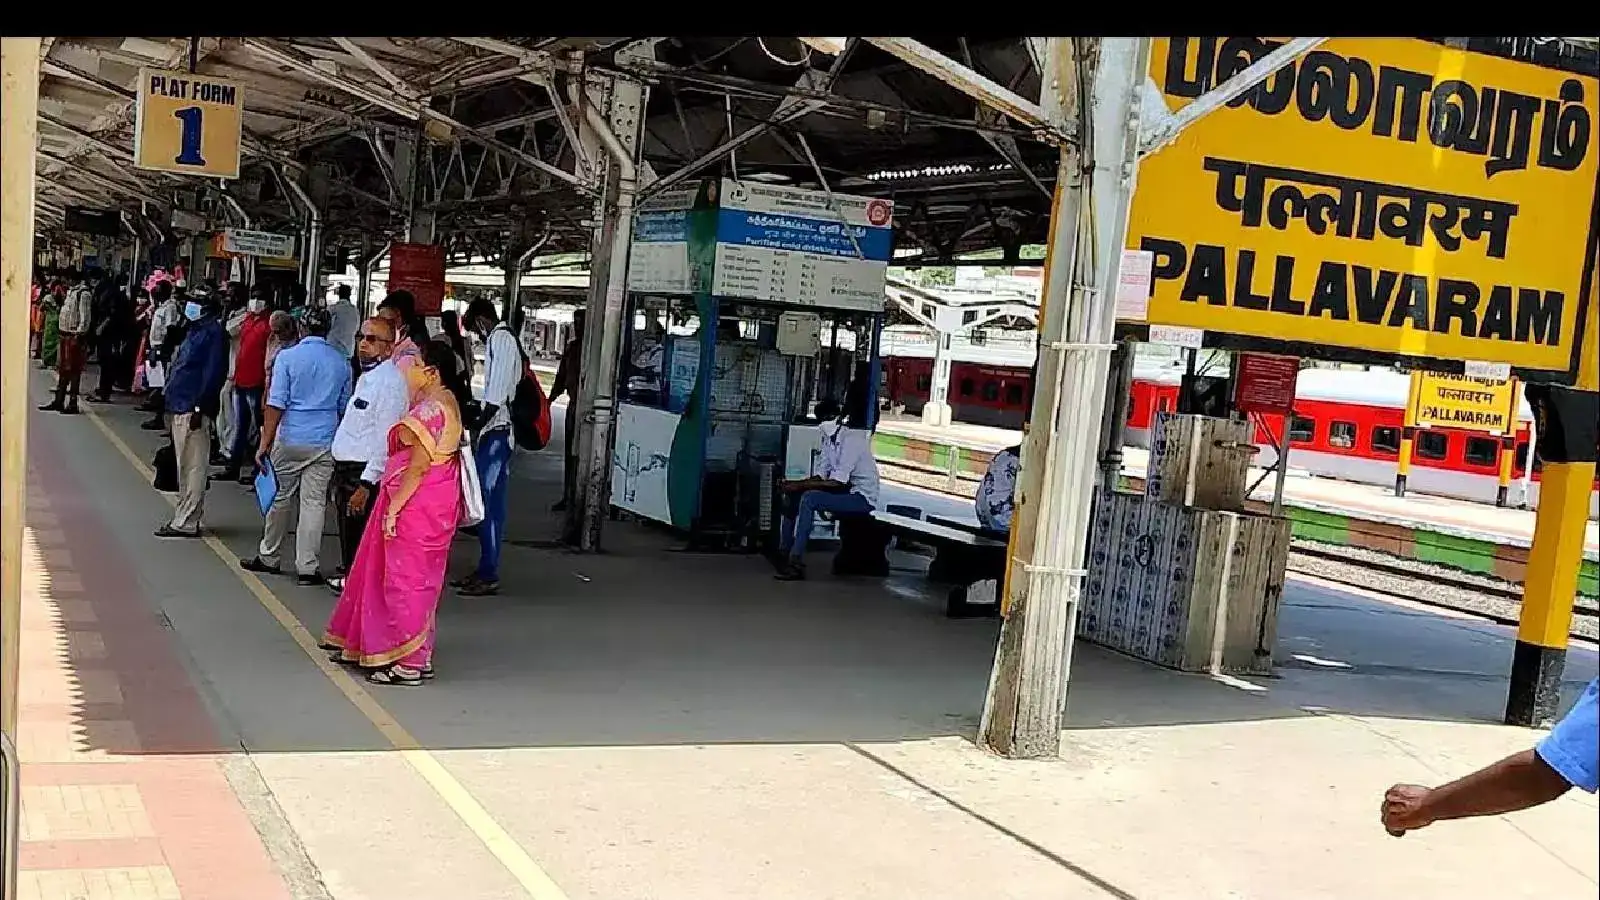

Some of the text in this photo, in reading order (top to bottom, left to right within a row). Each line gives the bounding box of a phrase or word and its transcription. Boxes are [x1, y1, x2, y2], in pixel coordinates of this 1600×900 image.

[151, 75, 236, 105] PLAT FORM
[175, 106, 206, 166] 1
[1203, 157, 1519, 259] पल्लावरम
[1141, 237, 1565, 347] PALLAVARAM
[1423, 406, 1503, 427] PALLAVARAM
